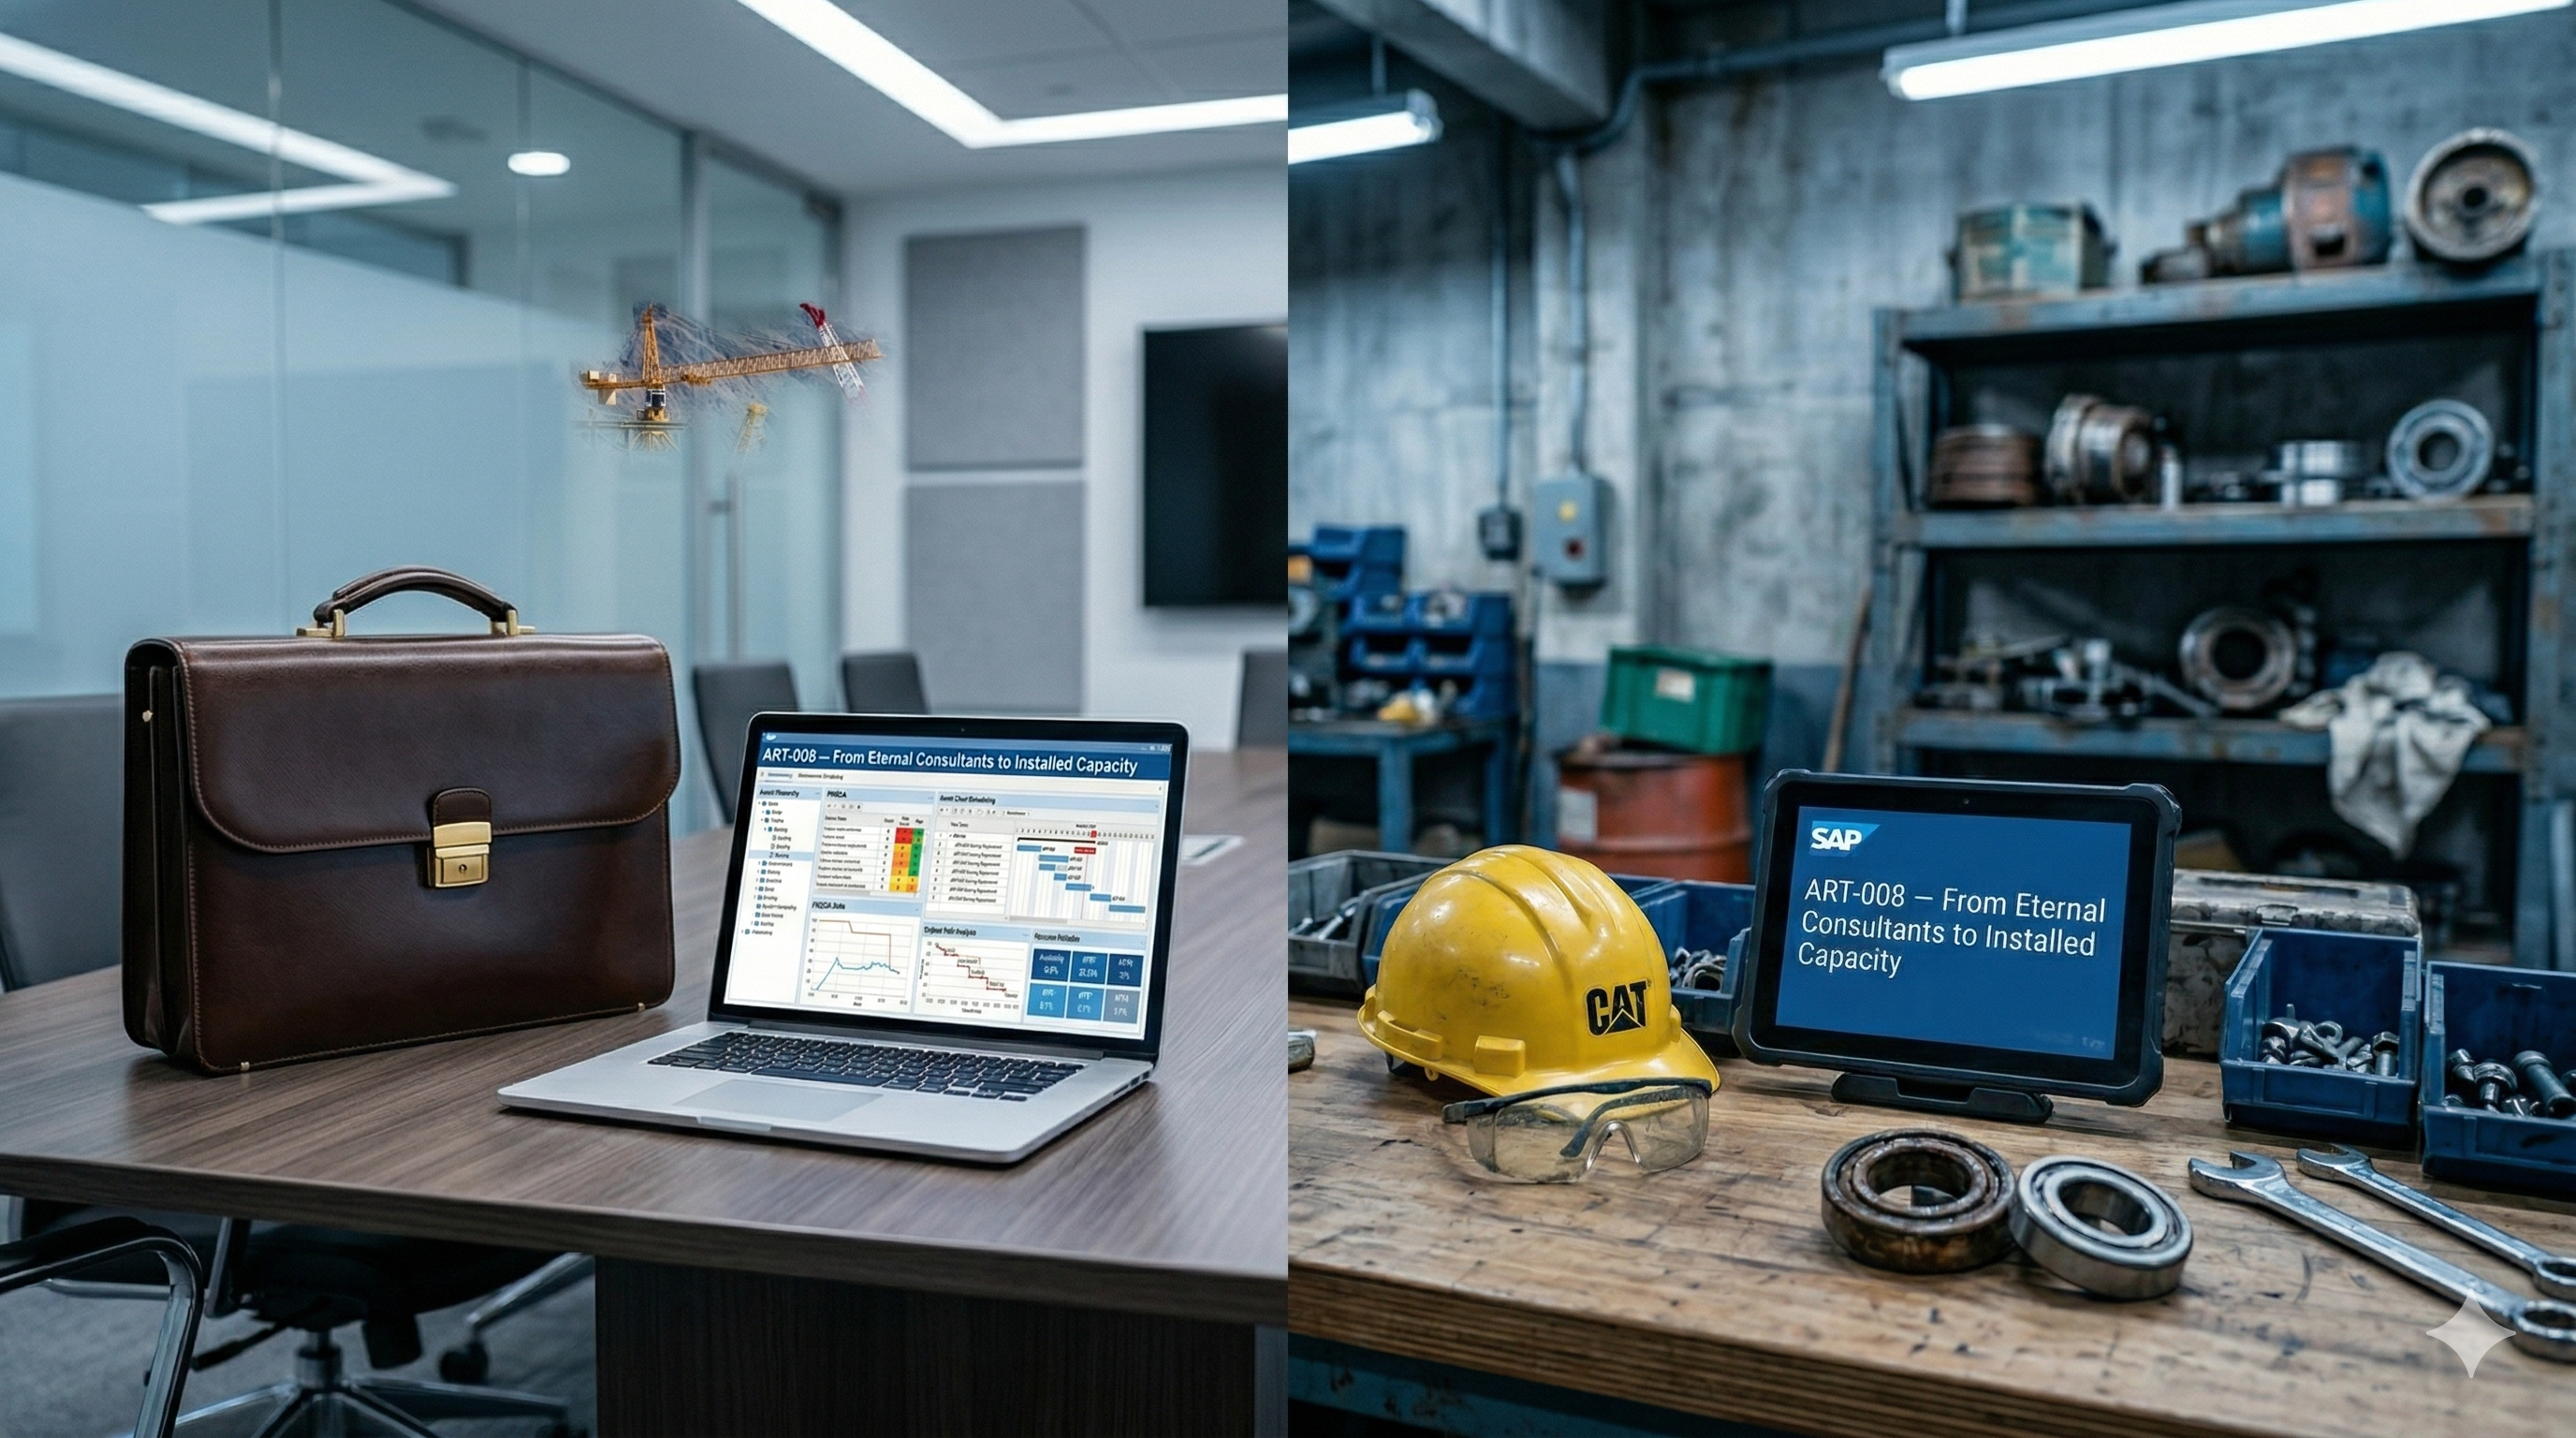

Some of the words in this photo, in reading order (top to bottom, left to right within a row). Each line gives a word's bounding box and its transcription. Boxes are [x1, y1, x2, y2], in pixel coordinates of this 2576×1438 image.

[762, 747, 817, 764] ART-008
[832, 749, 865, 765] From
[868, 750, 914, 767] Eternal
[915, 752, 994, 770] Consultants
[998, 755, 1012, 770] to
[1015, 755, 1074, 771] Installed
[1076, 756, 1138, 777] Capacity
[1810, 827, 1863, 851] SAP
[1804, 878, 1906, 908] ART-008
[1942, 888, 2007, 916] From
[2015, 892, 2106, 923] Eternal
[1802, 910, 1945, 944] Consultants
[1953, 923, 1978, 946] to
[1985, 924, 2096, 957] Installed
[1798, 941, 1902, 979] Capacity
[1586, 980, 1647, 1036] CAT
